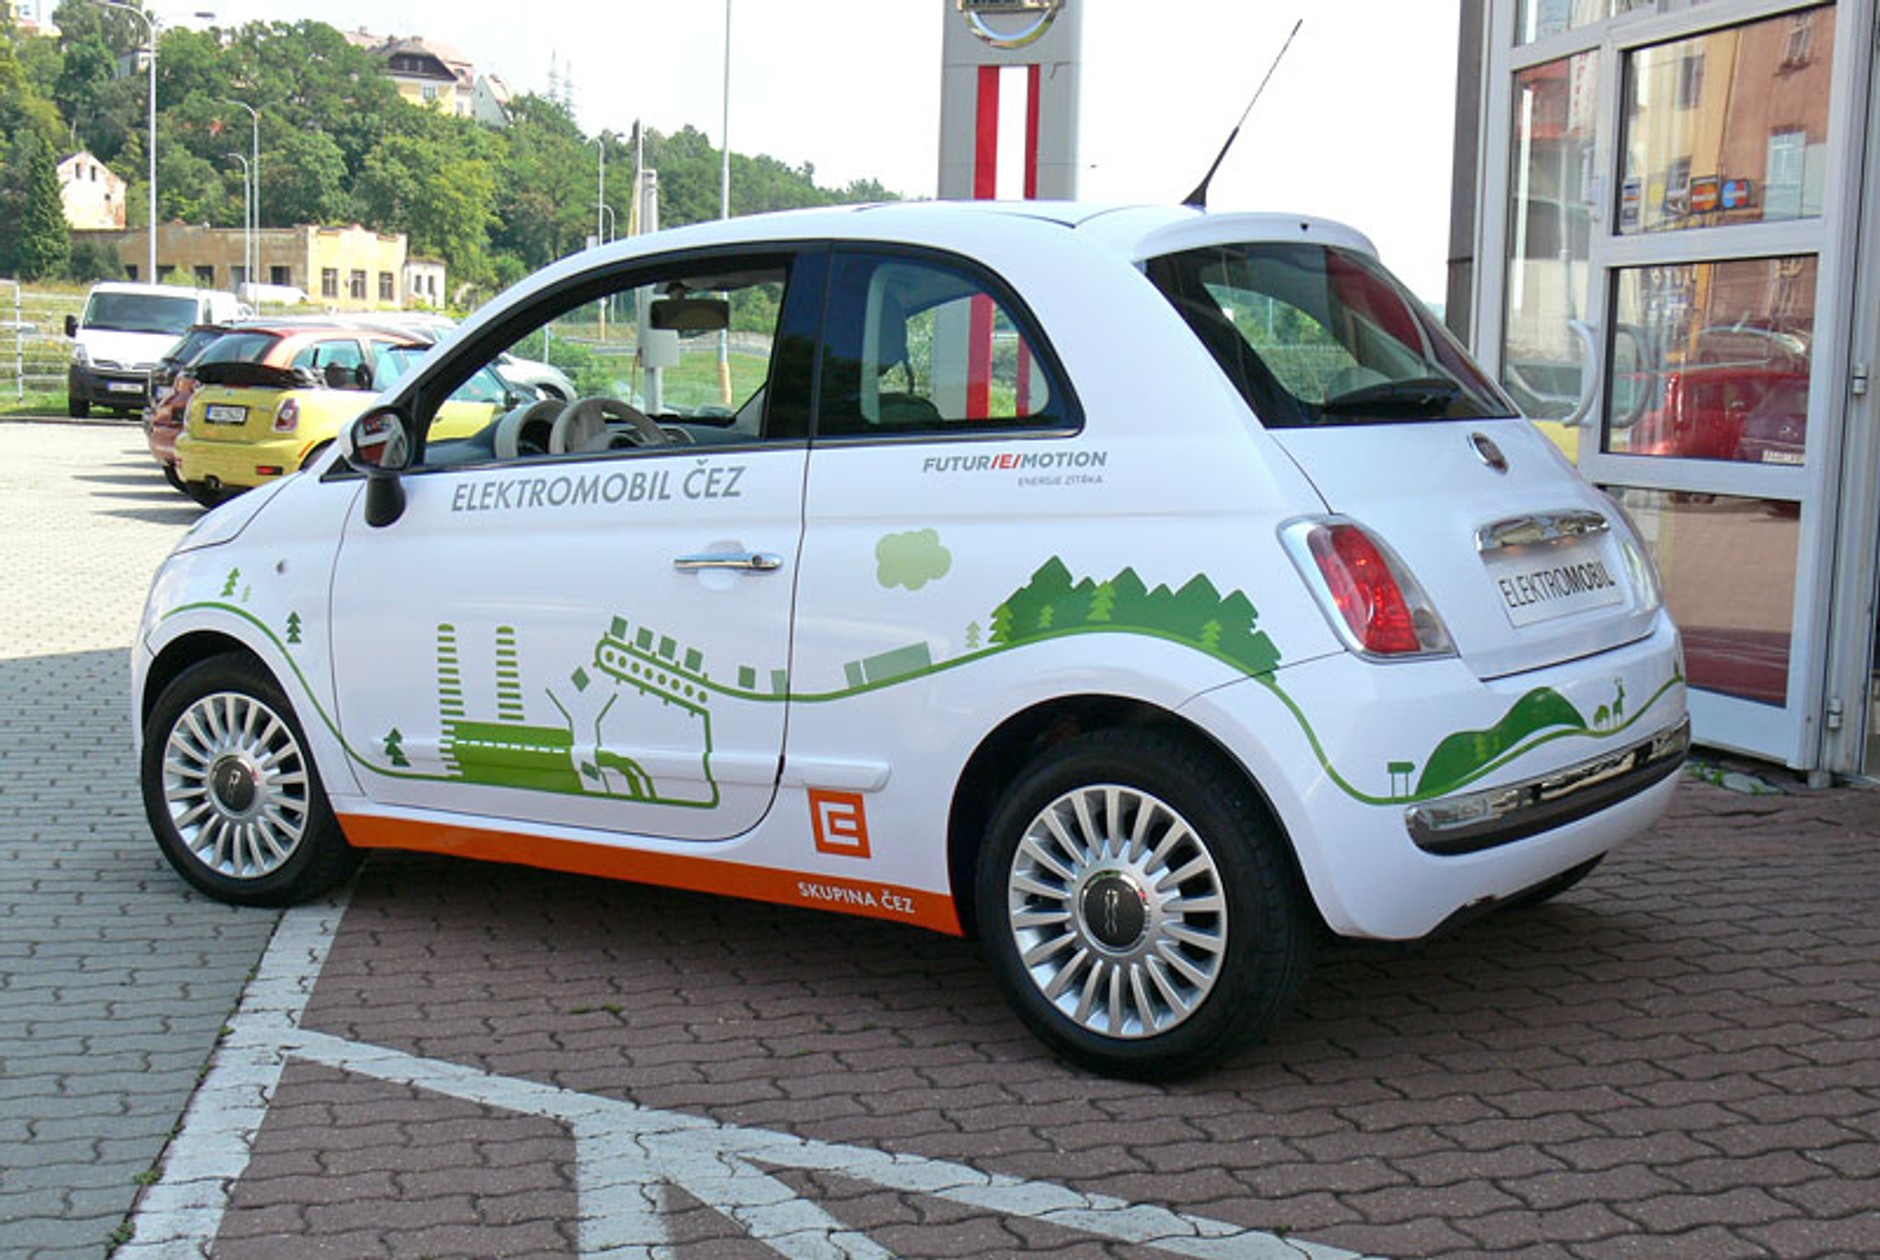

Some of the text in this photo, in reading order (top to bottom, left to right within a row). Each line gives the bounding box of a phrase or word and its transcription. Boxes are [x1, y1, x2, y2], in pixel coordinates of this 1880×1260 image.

[922, 451, 1107, 473] FUTUR/E/MOTION
[451, 458, 746, 512] ELEKTROMOBIL ČEZ
[1498, 561, 1616, 608] ELEKTROMOBIL
[797, 881, 916, 914] SKUPINA ČEZ
